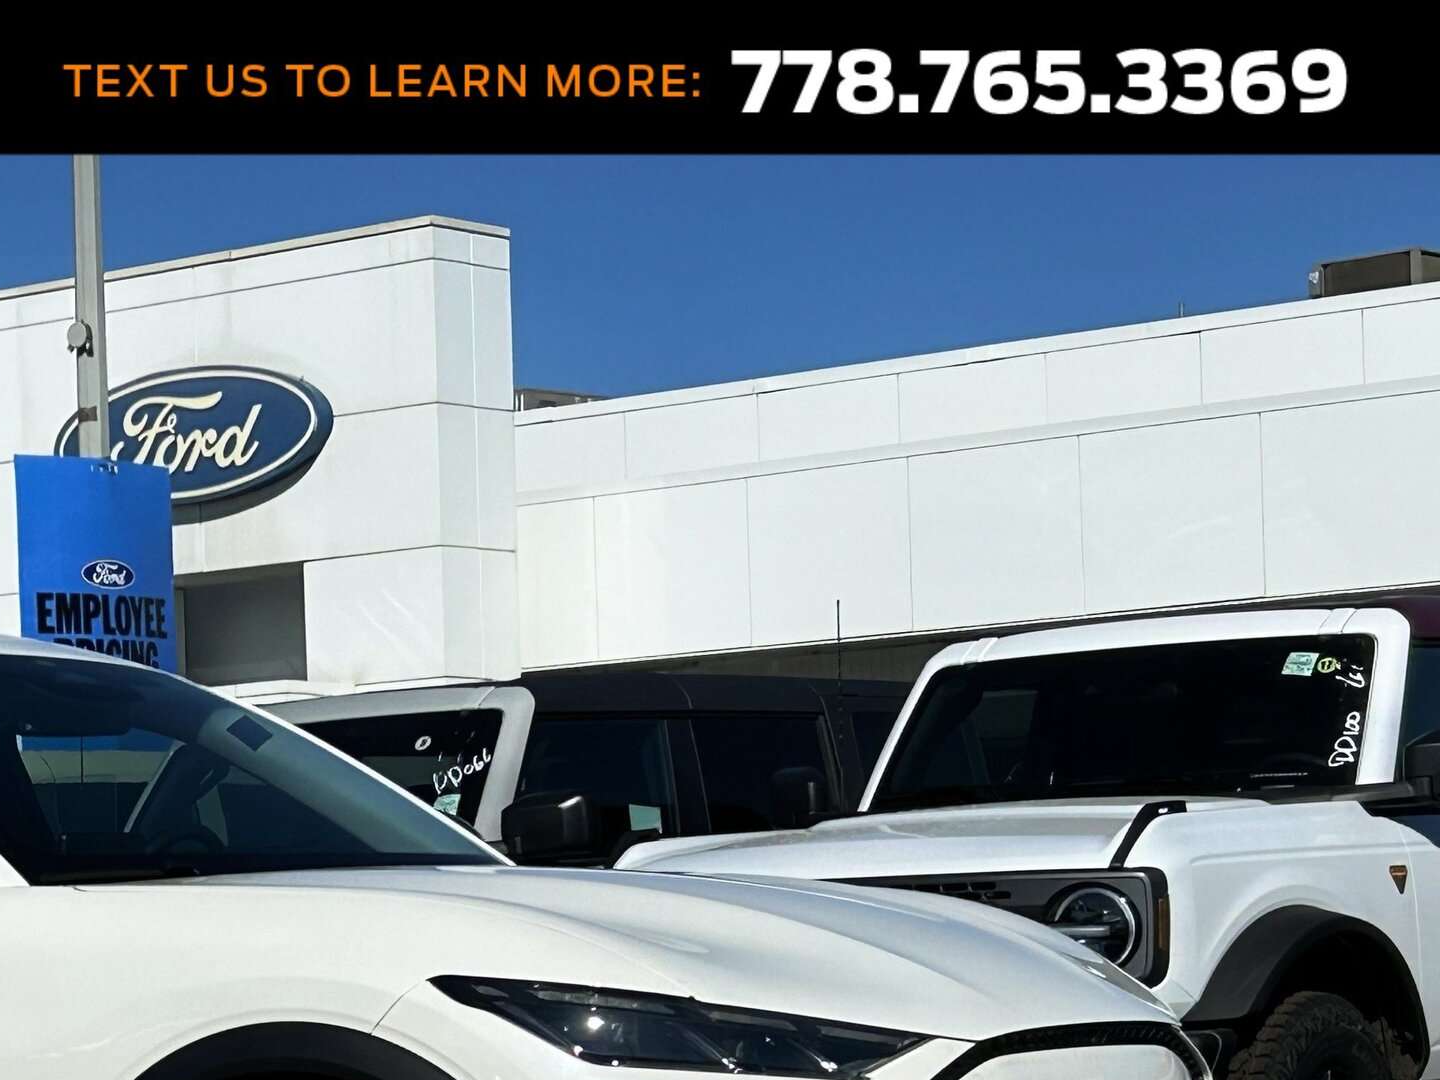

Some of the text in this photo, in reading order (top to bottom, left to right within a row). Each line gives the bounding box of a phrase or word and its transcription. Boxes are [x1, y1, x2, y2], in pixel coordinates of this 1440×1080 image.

[111, 391, 262, 473] Ford
[92, 562, 126, 586] Ford
[36, 592, 167, 638] EMPLOYEE
